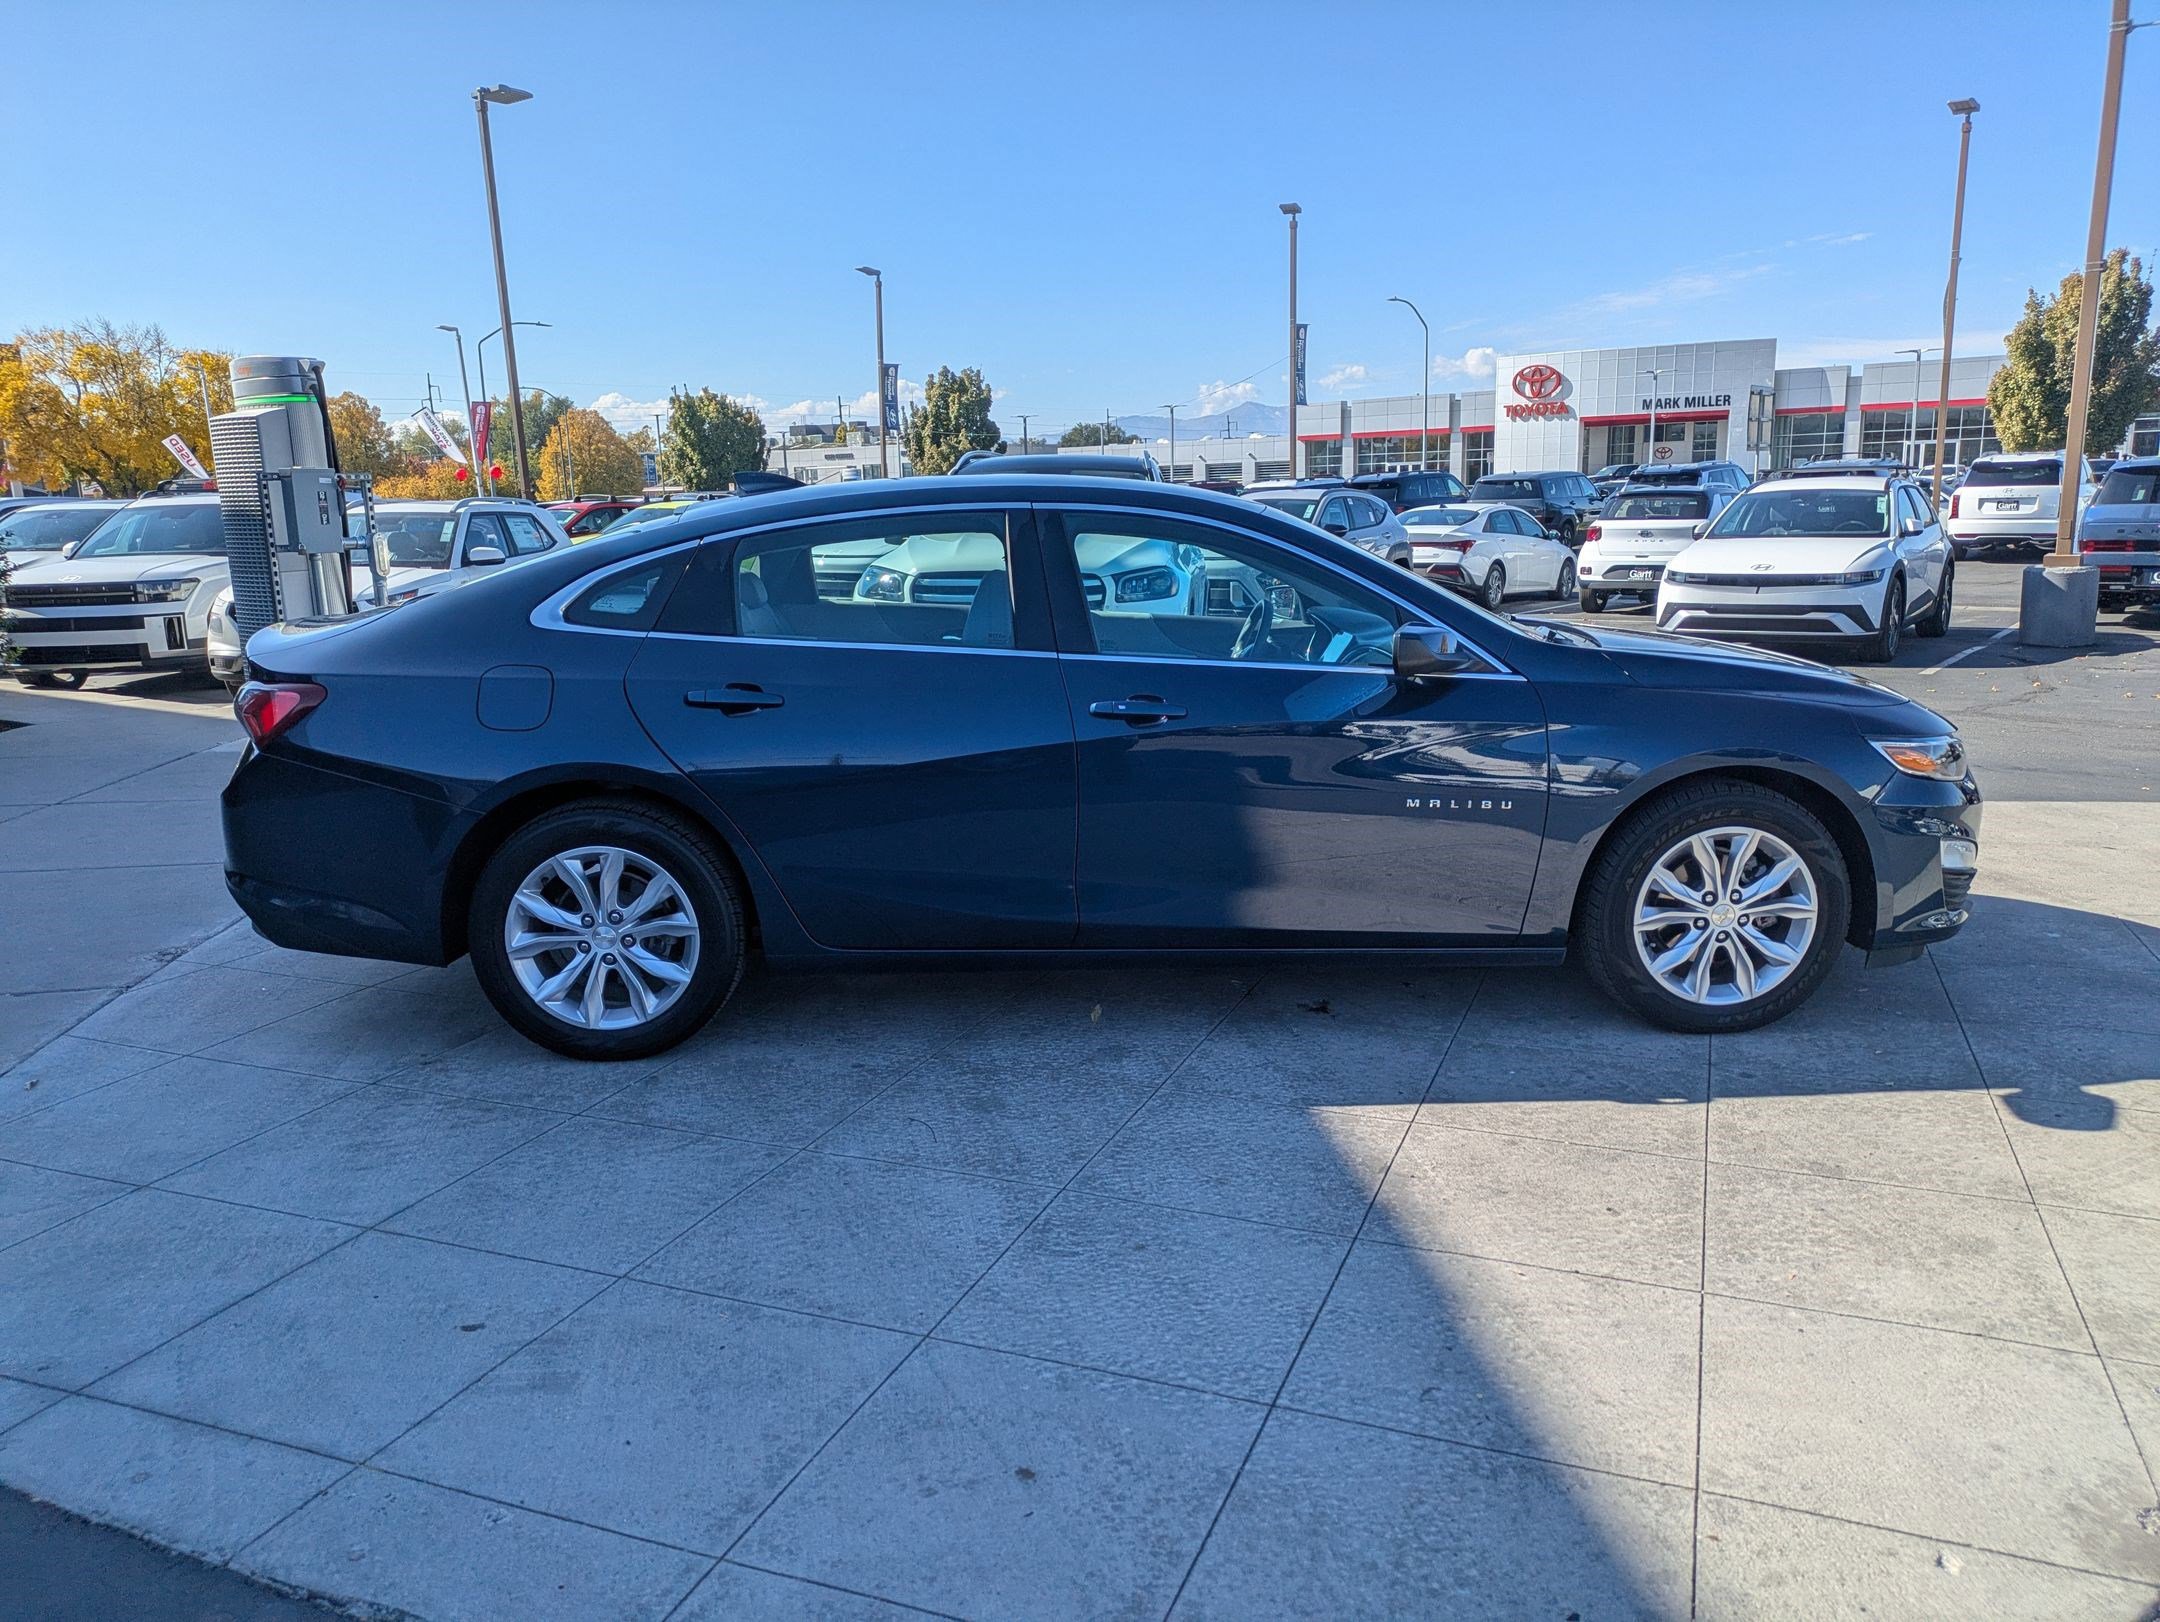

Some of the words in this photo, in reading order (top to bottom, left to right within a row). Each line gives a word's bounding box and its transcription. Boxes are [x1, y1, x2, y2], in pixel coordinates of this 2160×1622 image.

[1503, 401, 1569, 418] TOYOTA
[1642, 395, 1680, 411] MARK
[1684, 394, 1732, 409] MILLER
[1405, 798, 1513, 810] MALIBU
